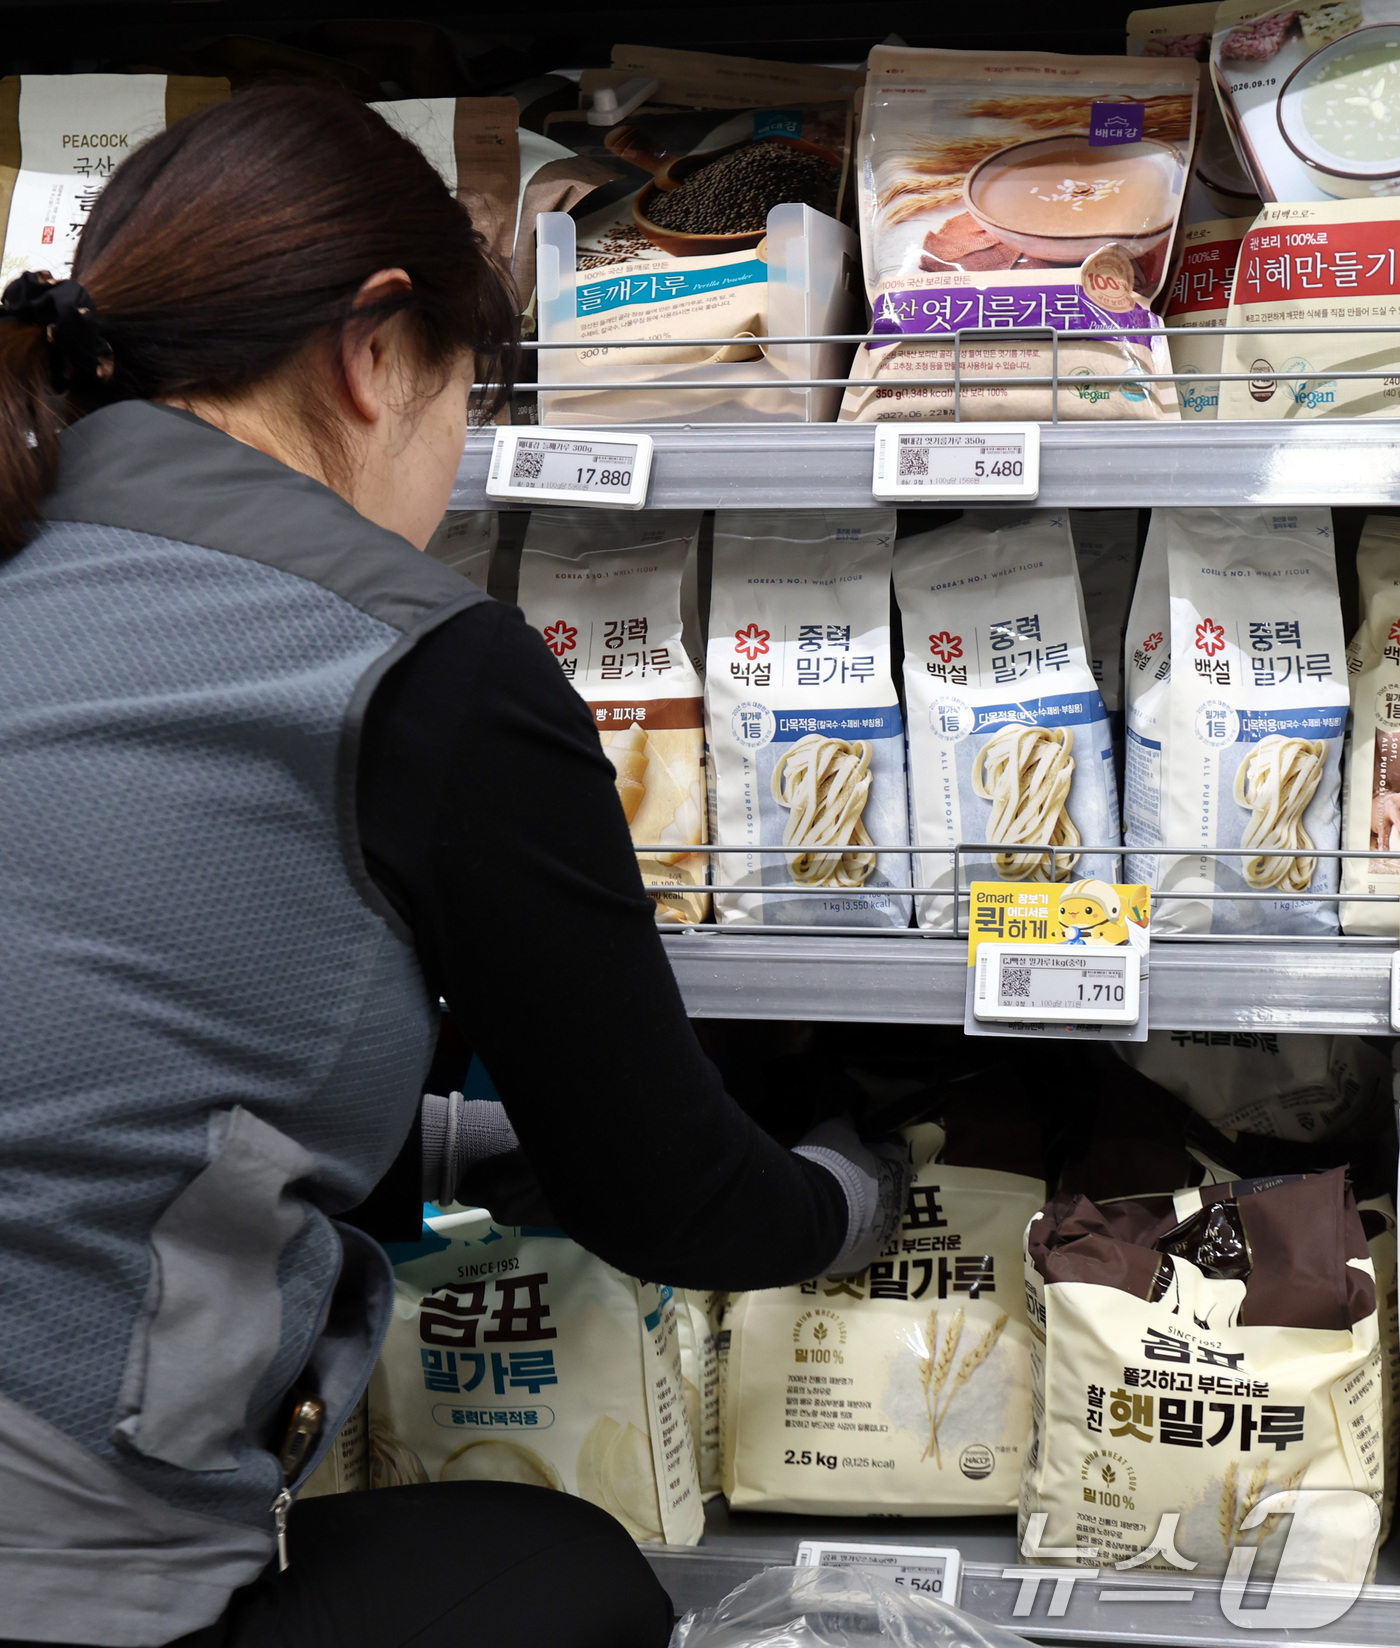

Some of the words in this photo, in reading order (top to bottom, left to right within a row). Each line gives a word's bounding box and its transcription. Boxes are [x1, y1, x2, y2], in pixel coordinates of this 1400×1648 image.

[62, 134, 129, 149] PEACOCK
[73, 155, 116, 178] 국산
[1261, 235, 1281, 249] 보리
[1285, 233, 1328, 247] 100%로
[580, 271, 606, 280] 100%
[608, 266, 624, 274] 국산
[626, 263, 651, 272] 들깨로
[652, 262, 669, 271] 만든
[722, 273, 754, 284] Powder
[1246, 248, 1395, 293] 식혜만들기
[882, 280, 905, 290] 100%
[907, 279, 924, 288] 국산
[926, 276, 951, 286] 보리로
[954, 275, 971, 285] 만든
[577, 275, 690, 311] 들깨가루
[923, 292, 1085, 331] 엿기름가루
[1286, 312, 1304, 320] 깨끗한
[1306, 310, 1328, 318] 식혜를
[1330, 308, 1345, 317] 직접
[1348, 307, 1369, 316] 만들어
[1371, 306, 1386, 316] 드실
[1389, 307, 1396, 315] 수
[876, 389, 893, 398] 350
[931, 388, 953, 398] kcal)
[971, 388, 984, 397] 보리
[987, 388, 1008, 397] 100%
[1074, 384, 1110, 404] Vegan
[1289, 384, 1335, 409] Vegan
[572, 444, 592, 453] 300g
[964, 437, 985, 445] 350g
[577, 468, 631, 486] 17,880
[975, 460, 1022, 478] 5,480
[930, 579, 965, 592] KOREA'S
[968, 574, 988, 584] NO.1
[991, 568, 1017, 579] WHEAT
[1020, 561, 1044, 571] FLOUR
[1285, 568, 1310, 576] FLOUR
[604, 617, 648, 650] 강력
[798, 624, 850, 652] 중력
[989, 614, 1042, 652] 중력
[1249, 620, 1302, 652] 중력
[601, 648, 672, 680] 밀가루
[926, 662, 968, 686] 백설
[992, 643, 1070, 684] 밀가루
[1134, 649, 1151, 671] 백설
[1194, 658, 1231, 685] 백설
[1252, 653, 1333, 686] 밀가루
[730, 662, 771, 687] 백설
[797, 656, 875, 686] 밀가루
[596, 707, 646, 721] 빵·피자용
[740, 712, 762, 721] 밀가루
[939, 715, 959, 732] 1등
[1206, 711, 1227, 719] 밀가루
[742, 722, 762, 739] 1등
[1206, 720, 1226, 738] 1등
[1381, 737, 1389, 753] ALL
[1390, 737, 1398, 766] SOFT,
[742, 757, 750, 776] ALL
[1379, 756, 1387, 797] PURPOSE
[744, 783, 753, 834] PURPOSE
[943, 778, 953, 830] PURPOSE
[1202, 784, 1210, 837] PURPOSE
[831, 902, 840, 912] kg
[976, 892, 1014, 904] emart
[1017, 893, 1049, 905] 장보기
[1280, 902, 1290, 911] kg
[975, 906, 1048, 939] 퀵하게
[1007, 907, 1048, 918] 어디서든
[1077, 984, 1125, 1002] 1,710
[902, 1185, 948, 1230] 표
[902, 1235, 961, 1254] 부드러운
[457, 1262, 494, 1278] SINCE
[496, 1257, 520, 1273] 1952
[419, 1272, 558, 1348] 곰표
[793, 1311, 812, 1343] PREMIUM
[815, 1309, 840, 1321] WHEAT
[1168, 1326, 1196, 1342] SINCE
[420, 1349, 558, 1395] 밀가루
[1124, 1367, 1193, 1392] 쫄깃하고
[1198, 1374, 1270, 1398] 부드러운
[451, 1409, 538, 1426] 중력다목적용
[1087, 1384, 1106, 1433] 찰진
[1109, 1388, 1305, 1452] 햇밀가루
[784, 1450, 812, 1465] 2.5
[816, 1452, 837, 1469] kg
[872, 1458, 895, 1469] kcal)
[1081, 1450, 1100, 1480] PREMIUM
[1101, 1450, 1128, 1466] WHEAT
[1126, 1467, 1137, 1492] FLOUR
